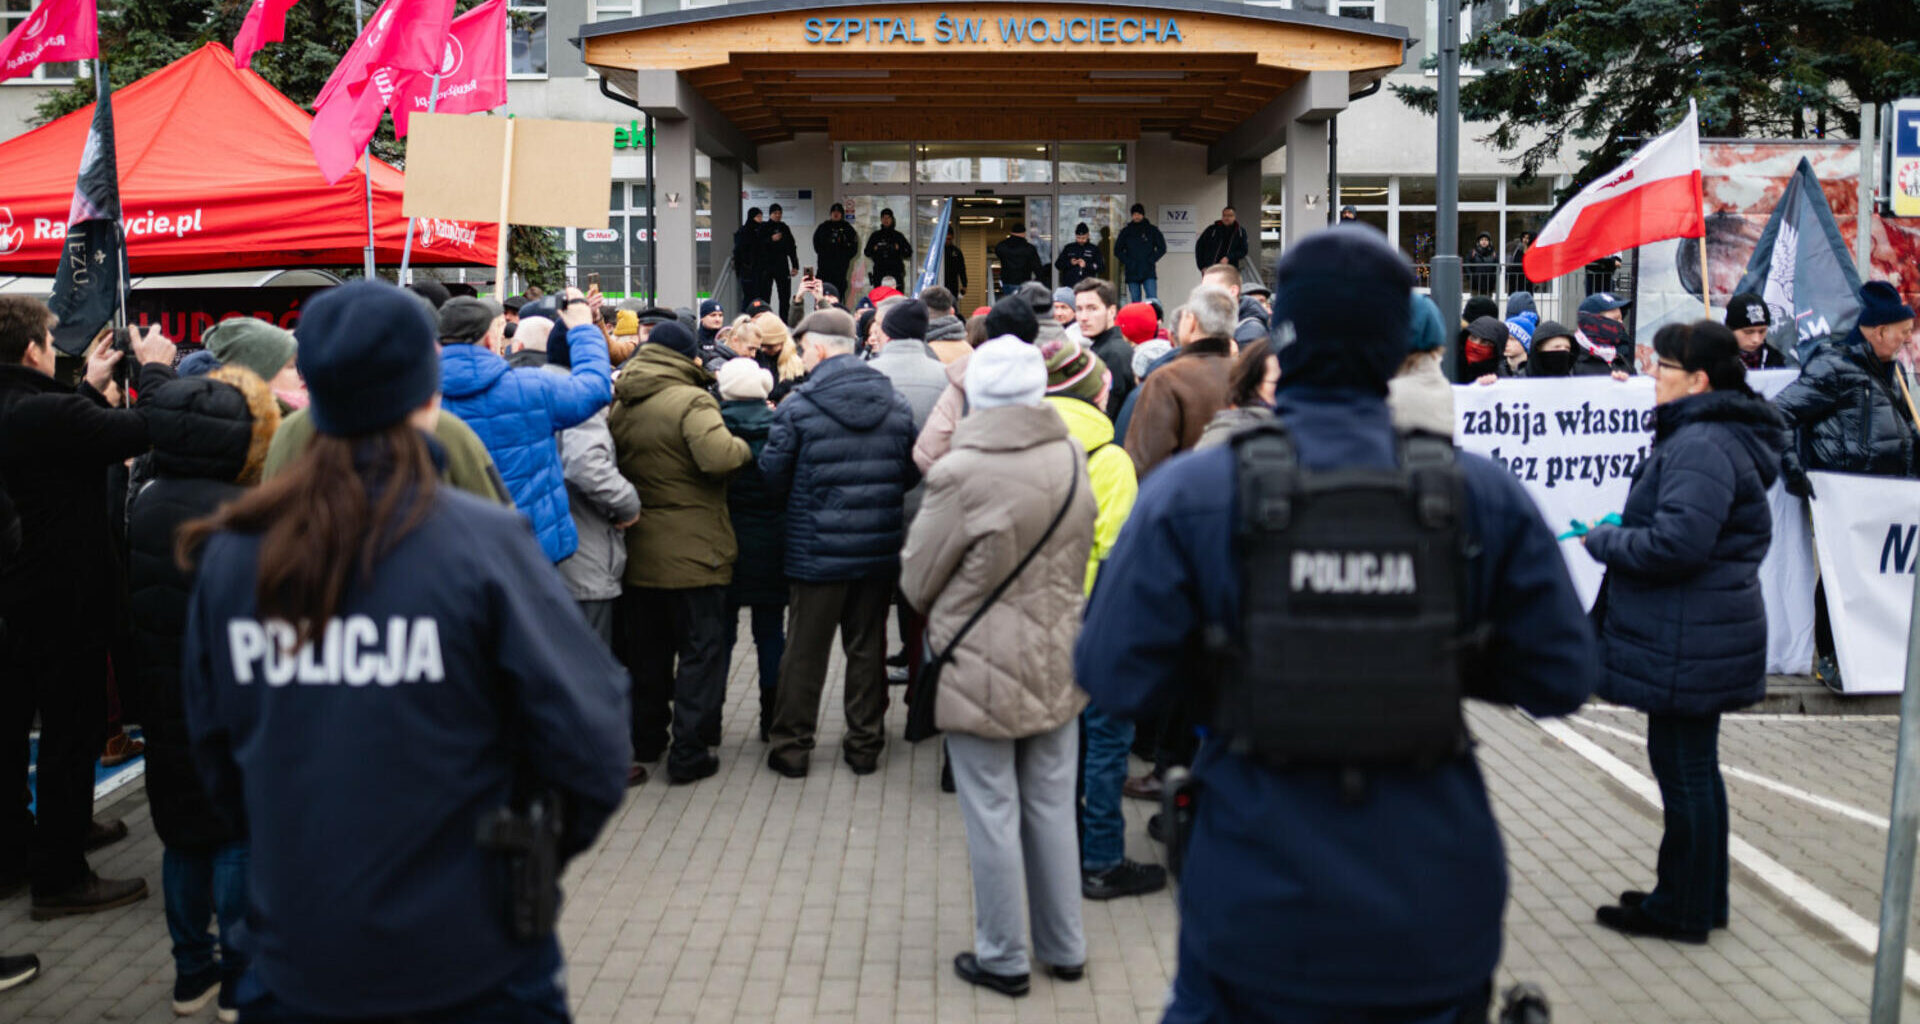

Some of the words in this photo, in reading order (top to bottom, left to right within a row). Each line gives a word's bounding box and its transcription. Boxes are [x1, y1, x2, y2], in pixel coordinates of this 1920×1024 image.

[804, 17, 925, 43] SZPITAL
[934, 11, 988, 43] ŚW.
[998, 17, 1182, 43] WOJCIECHA
[34, 208, 202, 239] Raycie.pl
[1463, 402, 1546, 444] zabija
[1880, 523, 1918, 574] N
[1291, 551, 1416, 594] POLICJA
[227, 614, 446, 687] POLICJA
